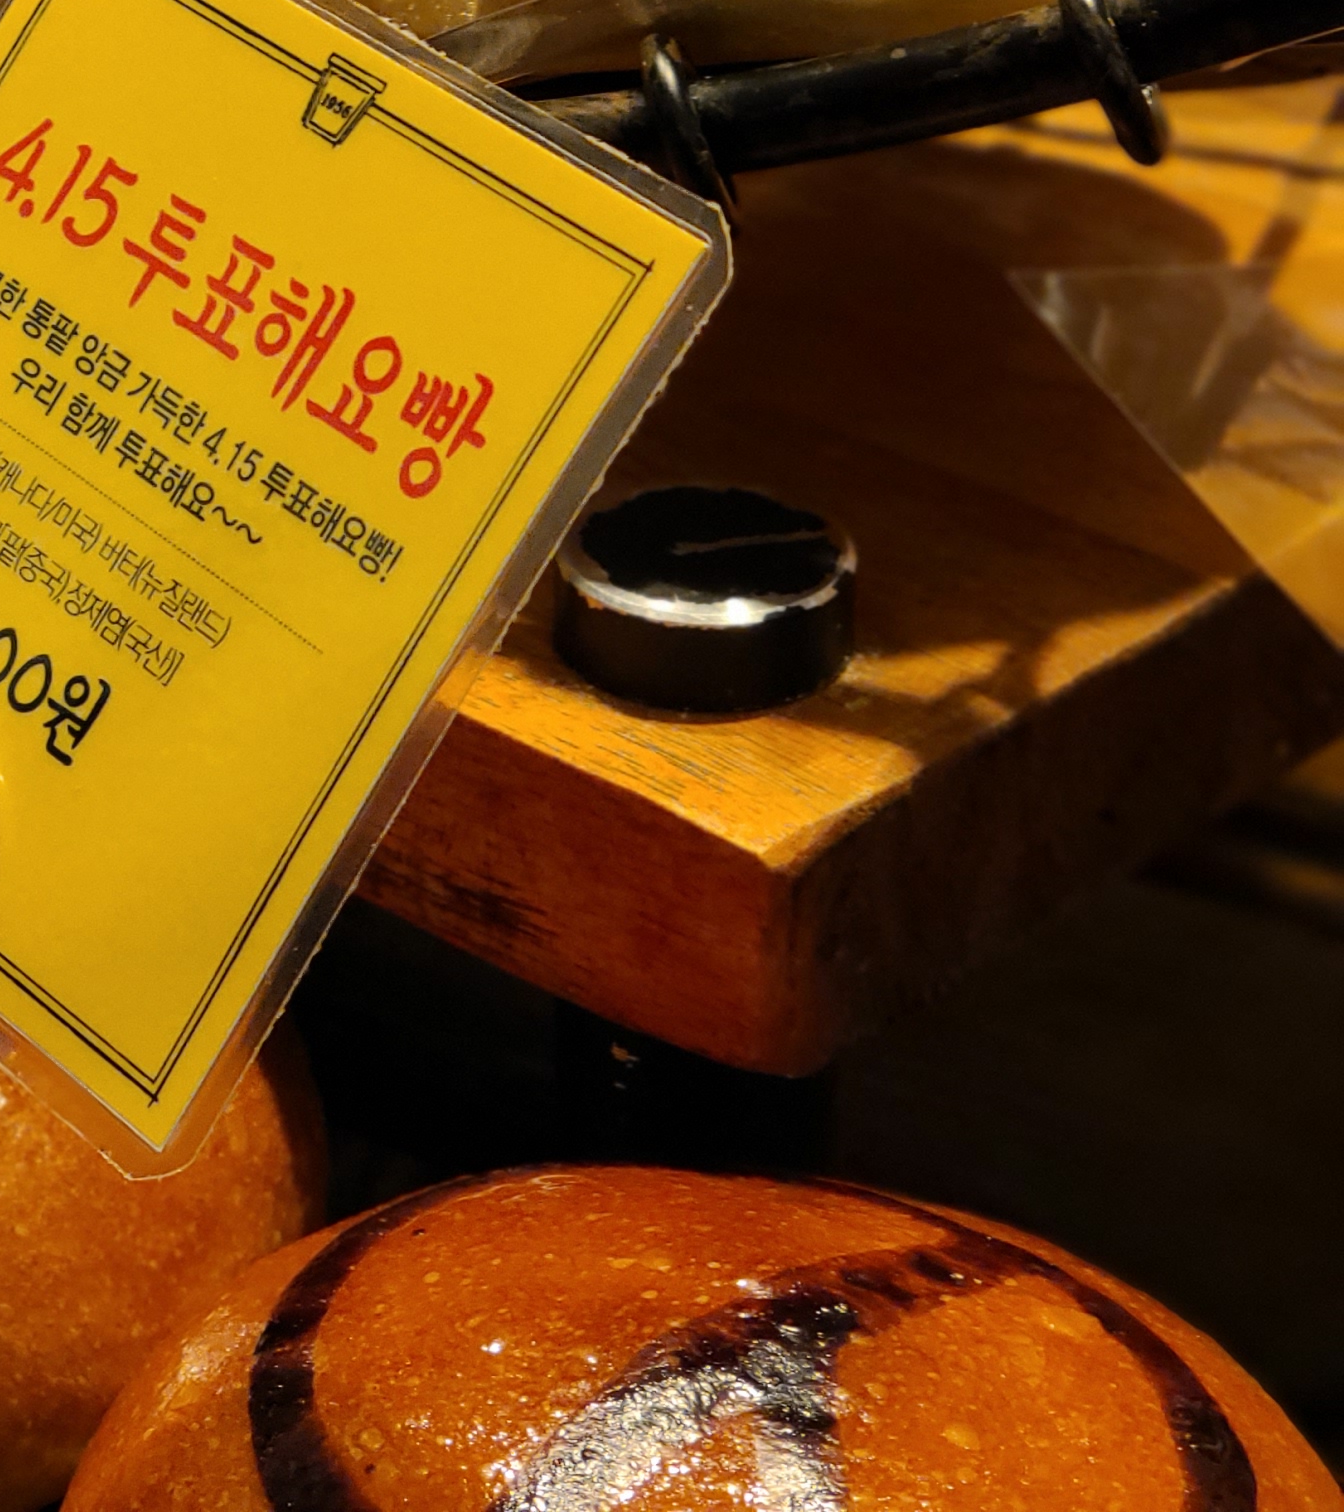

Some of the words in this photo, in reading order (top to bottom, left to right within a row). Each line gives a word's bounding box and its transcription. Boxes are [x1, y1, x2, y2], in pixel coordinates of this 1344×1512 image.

[320, 93, 353, 119] 1956
[122, 193, 494, 499] 투표해요빵
[11, 356, 67, 417] 우리
[61, 392, 122, 454] 함께
[114, 429, 264, 545] 투표해요~~
[22, 298, 79, 356] 통팥
[70, 334, 132, 389] 앙금
[127, 371, 208, 445] 가득한
[202, 426, 265, 483] 4.15
[259, 461, 405, 584] 투표해요빵!
[98, 535, 233, 649] 버터(뉴질랜드)
